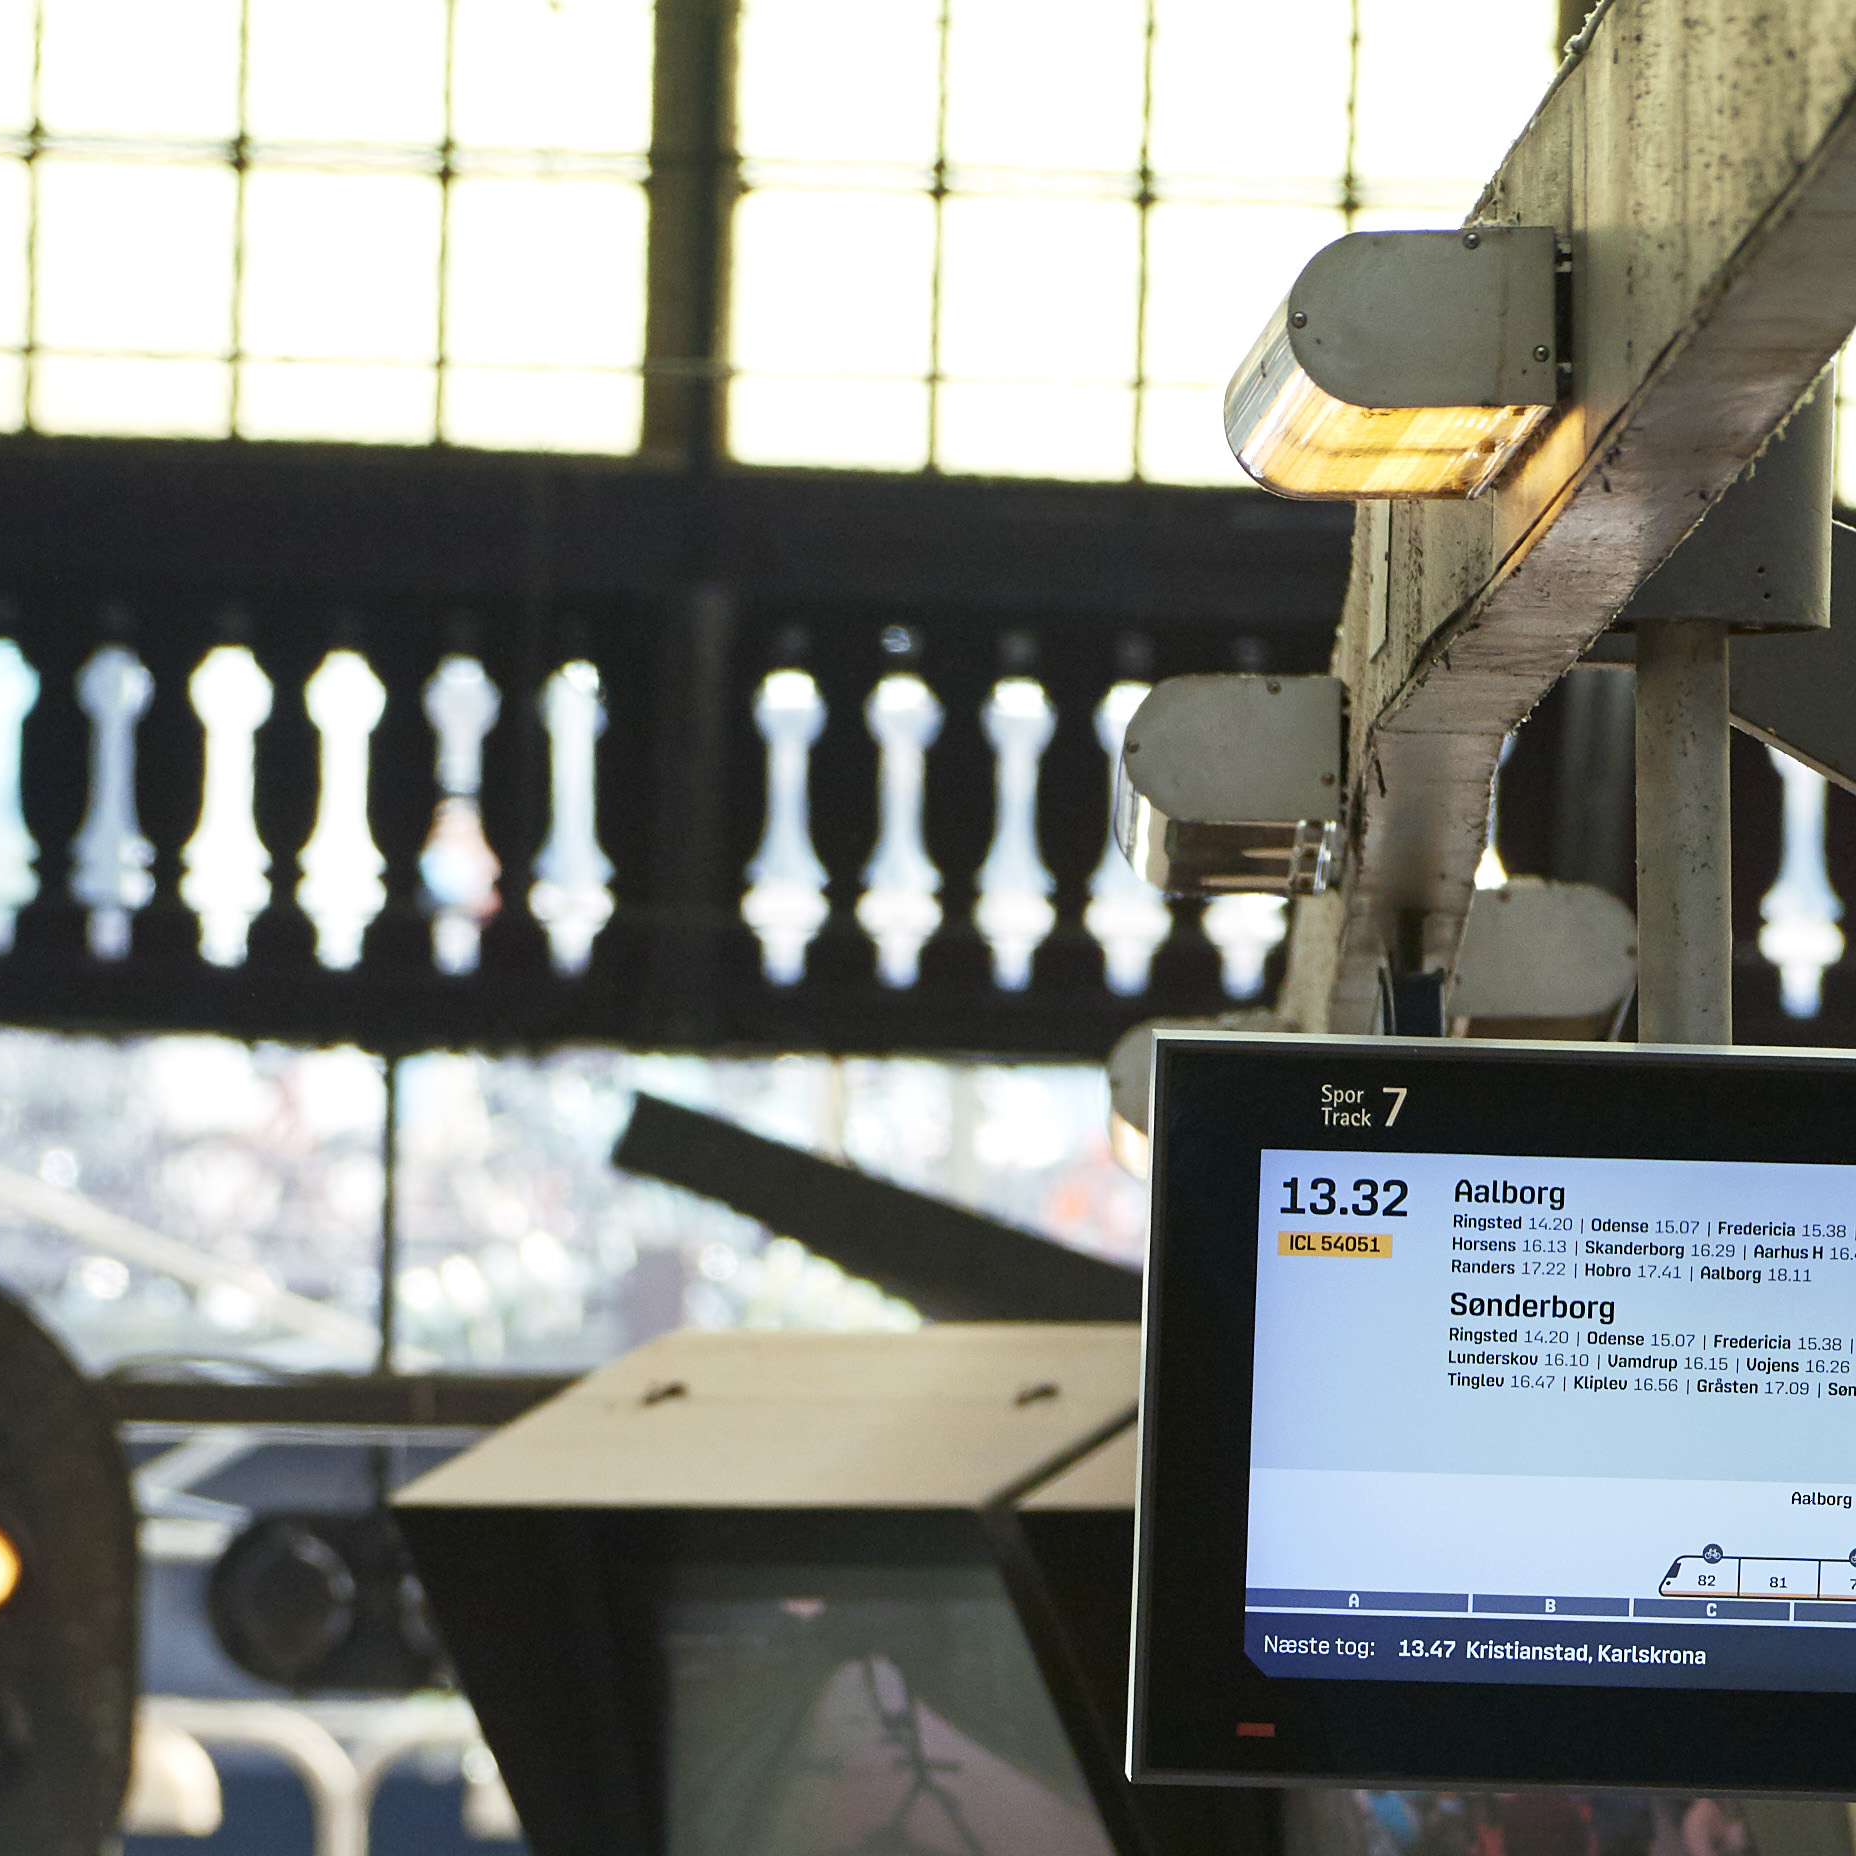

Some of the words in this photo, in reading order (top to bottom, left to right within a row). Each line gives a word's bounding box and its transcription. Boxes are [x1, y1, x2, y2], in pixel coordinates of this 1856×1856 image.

[1321, 1084, 1365, 1108] Spor
[1382, 1087, 1408, 1127] 7
[1321, 1107, 1372, 1127] Track
[1280, 1176, 1409, 1217] 13.32
[1454, 1178, 1565, 1211] Aalborg
[1453, 1213, 1522, 1232] Ringsted
[1528, 1217, 1573, 1231] 14.20
[1591, 1217, 1649, 1233] Odense
[1656, 1220, 1700, 1235] 15.07
[1718, 1221, 1796, 1237] Fredericia
[1801, 1224, 1847, 1238] 15.38
[1289, 1234, 1317, 1251] ICL
[1321, 1235, 1381, 1253] 54051
[1452, 1236, 1517, 1252] Horsens
[1522, 1239, 1567, 1253] 16.13
[1585, 1240, 1685, 1260] Skanderborg
[1691, 1243, 1736, 1258] 16.29
[1753, 1244, 1809, 1259] Aarhus
[1812, 1245, 1824, 1260] H
[1451, 1259, 1515, 1275] Randers
[1521, 1261, 1566, 1276] 17.22
[1584, 1262, 1632, 1278] Hobro
[1637, 1264, 1682, 1279] 17.41
[1700, 1265, 1762, 1284] Aalborg
[1768, 1268, 1812, 1283] 18.11
[1450, 1291, 1615, 1325] Sønderborg
[1449, 1326, 1518, 1345] Ringsted
[1524, 1330, 1569, 1344] 14.20
[1587, 1331, 1645, 1346] Odense
[1651, 1333, 1696, 1347] 15.07
[1713, 1334, 1791, 1350] Fredericia
[1797, 1336, 1842, 1351] 15.38
[1448, 1349, 1539, 1366] Lunderskov
[1544, 1353, 1589, 1367] 16.10
[1607, 1353, 1678, 1372] Vamdrup
[1684, 1356, 1728, 1371] 16.15
[1746, 1357, 1800, 1375] Vojens
[1805, 1359, 1850, 1374] 16.26
[1447, 1371, 1505, 1390] Tinglev
[1510, 1374, 1555, 1389] 16.47
[1573, 1375, 1628, 1393] Kliplev
[1633, 1377, 1678, 1392] 16.56
[1696, 1377, 1759, 1394] Gråsten
[1764, 1381, 1810, 1395] 17.09
[1791, 1491, 1852, 1509] Aalborg
[1697, 1574, 1716, 1587] 82
[1769, 1576, 1788, 1589] 81
[1348, 1593, 1360, 1608] A
[1545, 1598, 1556, 1613] B
[1706, 1602, 1718, 1617] C
[1264, 1634, 1330, 1655] Næste
[1334, 1637, 1375, 1659] tog:
[1398, 1639, 1456, 1659] 13.47
[1466, 1639, 1593, 1665] Kristianstad,
[1597, 1644, 1707, 1665] Karlskrona
